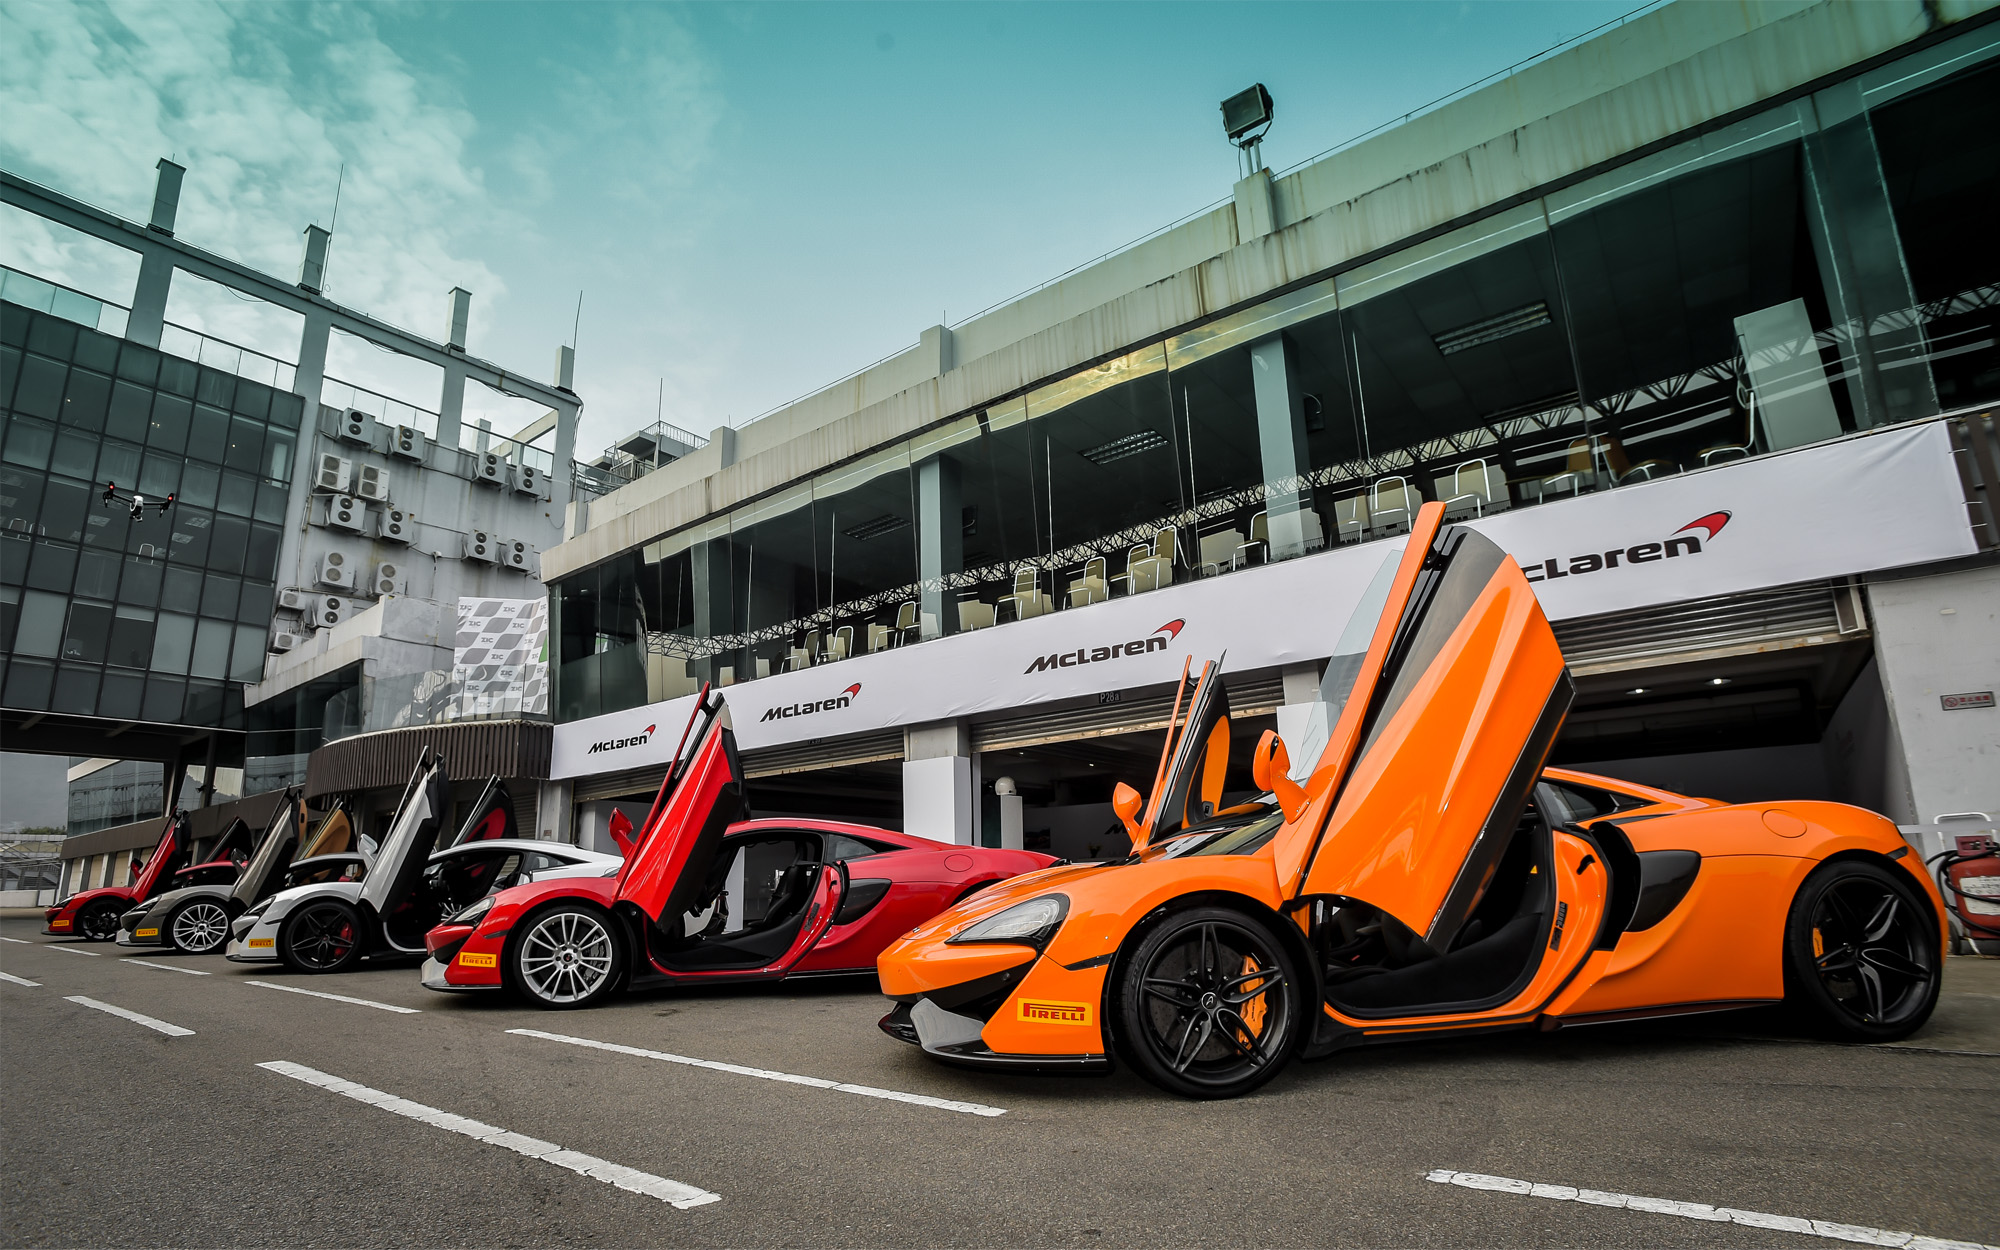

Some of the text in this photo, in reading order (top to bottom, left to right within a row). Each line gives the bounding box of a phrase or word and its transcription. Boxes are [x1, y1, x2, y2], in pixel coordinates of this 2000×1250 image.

[1524, 537, 1702, 582] cLaren
[1025, 637, 1167, 674] McLaren
[1100, 691, 1120, 703] P28a
[760, 697, 850, 723] McLaren
[587, 734, 648, 755] McLaren
[462, 955, 493, 965] PIRELLI
[1023, 1002, 1086, 1021] PIRELLI
